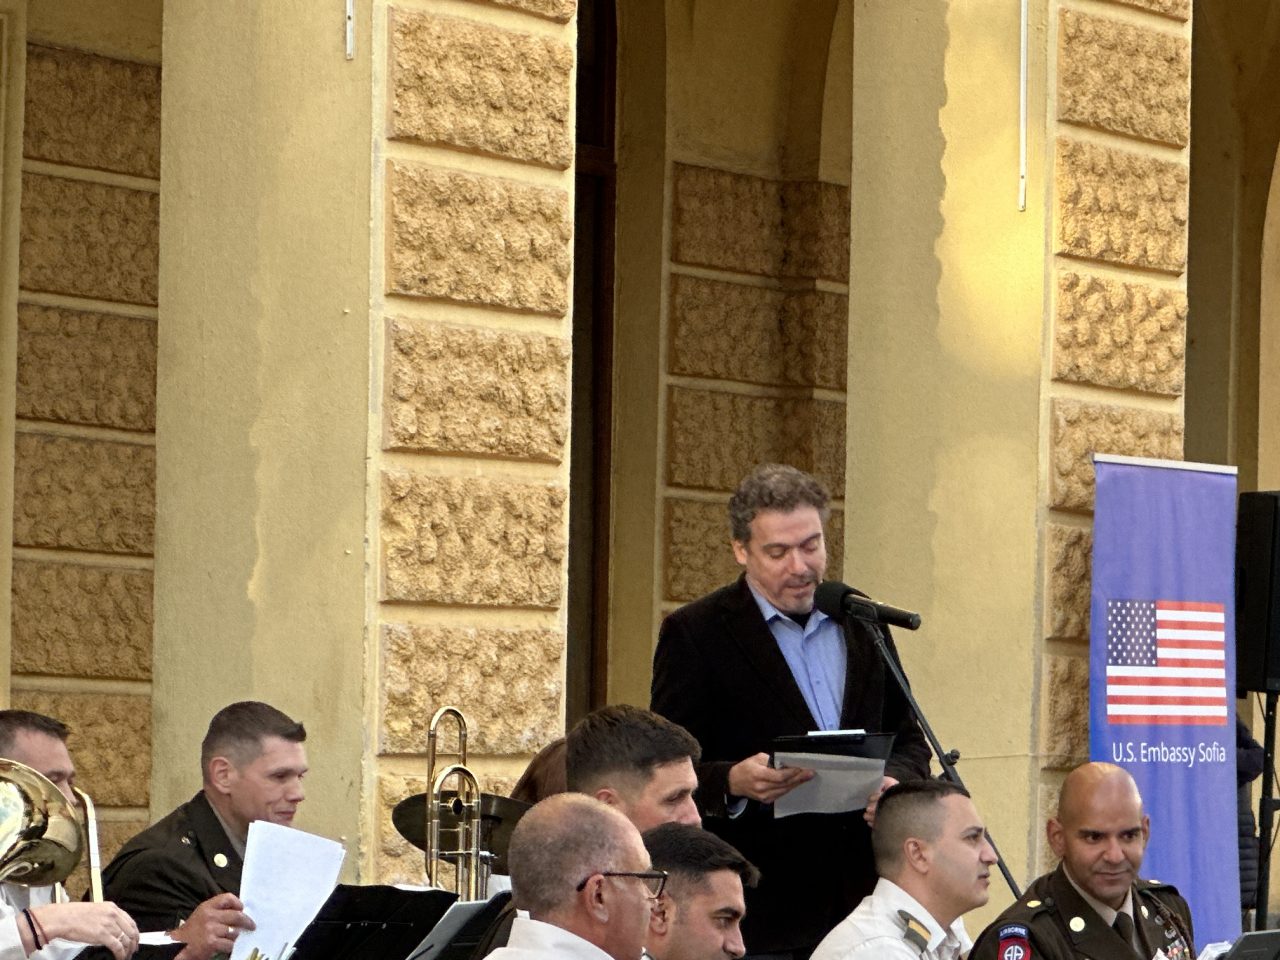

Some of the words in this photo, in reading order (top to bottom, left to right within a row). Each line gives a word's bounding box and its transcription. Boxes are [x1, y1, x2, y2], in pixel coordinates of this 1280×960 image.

[1112, 741, 1137, 763] U.S.
[1140, 741, 1196, 768] Embassy
[1198, 741, 1226, 763] Sofia
